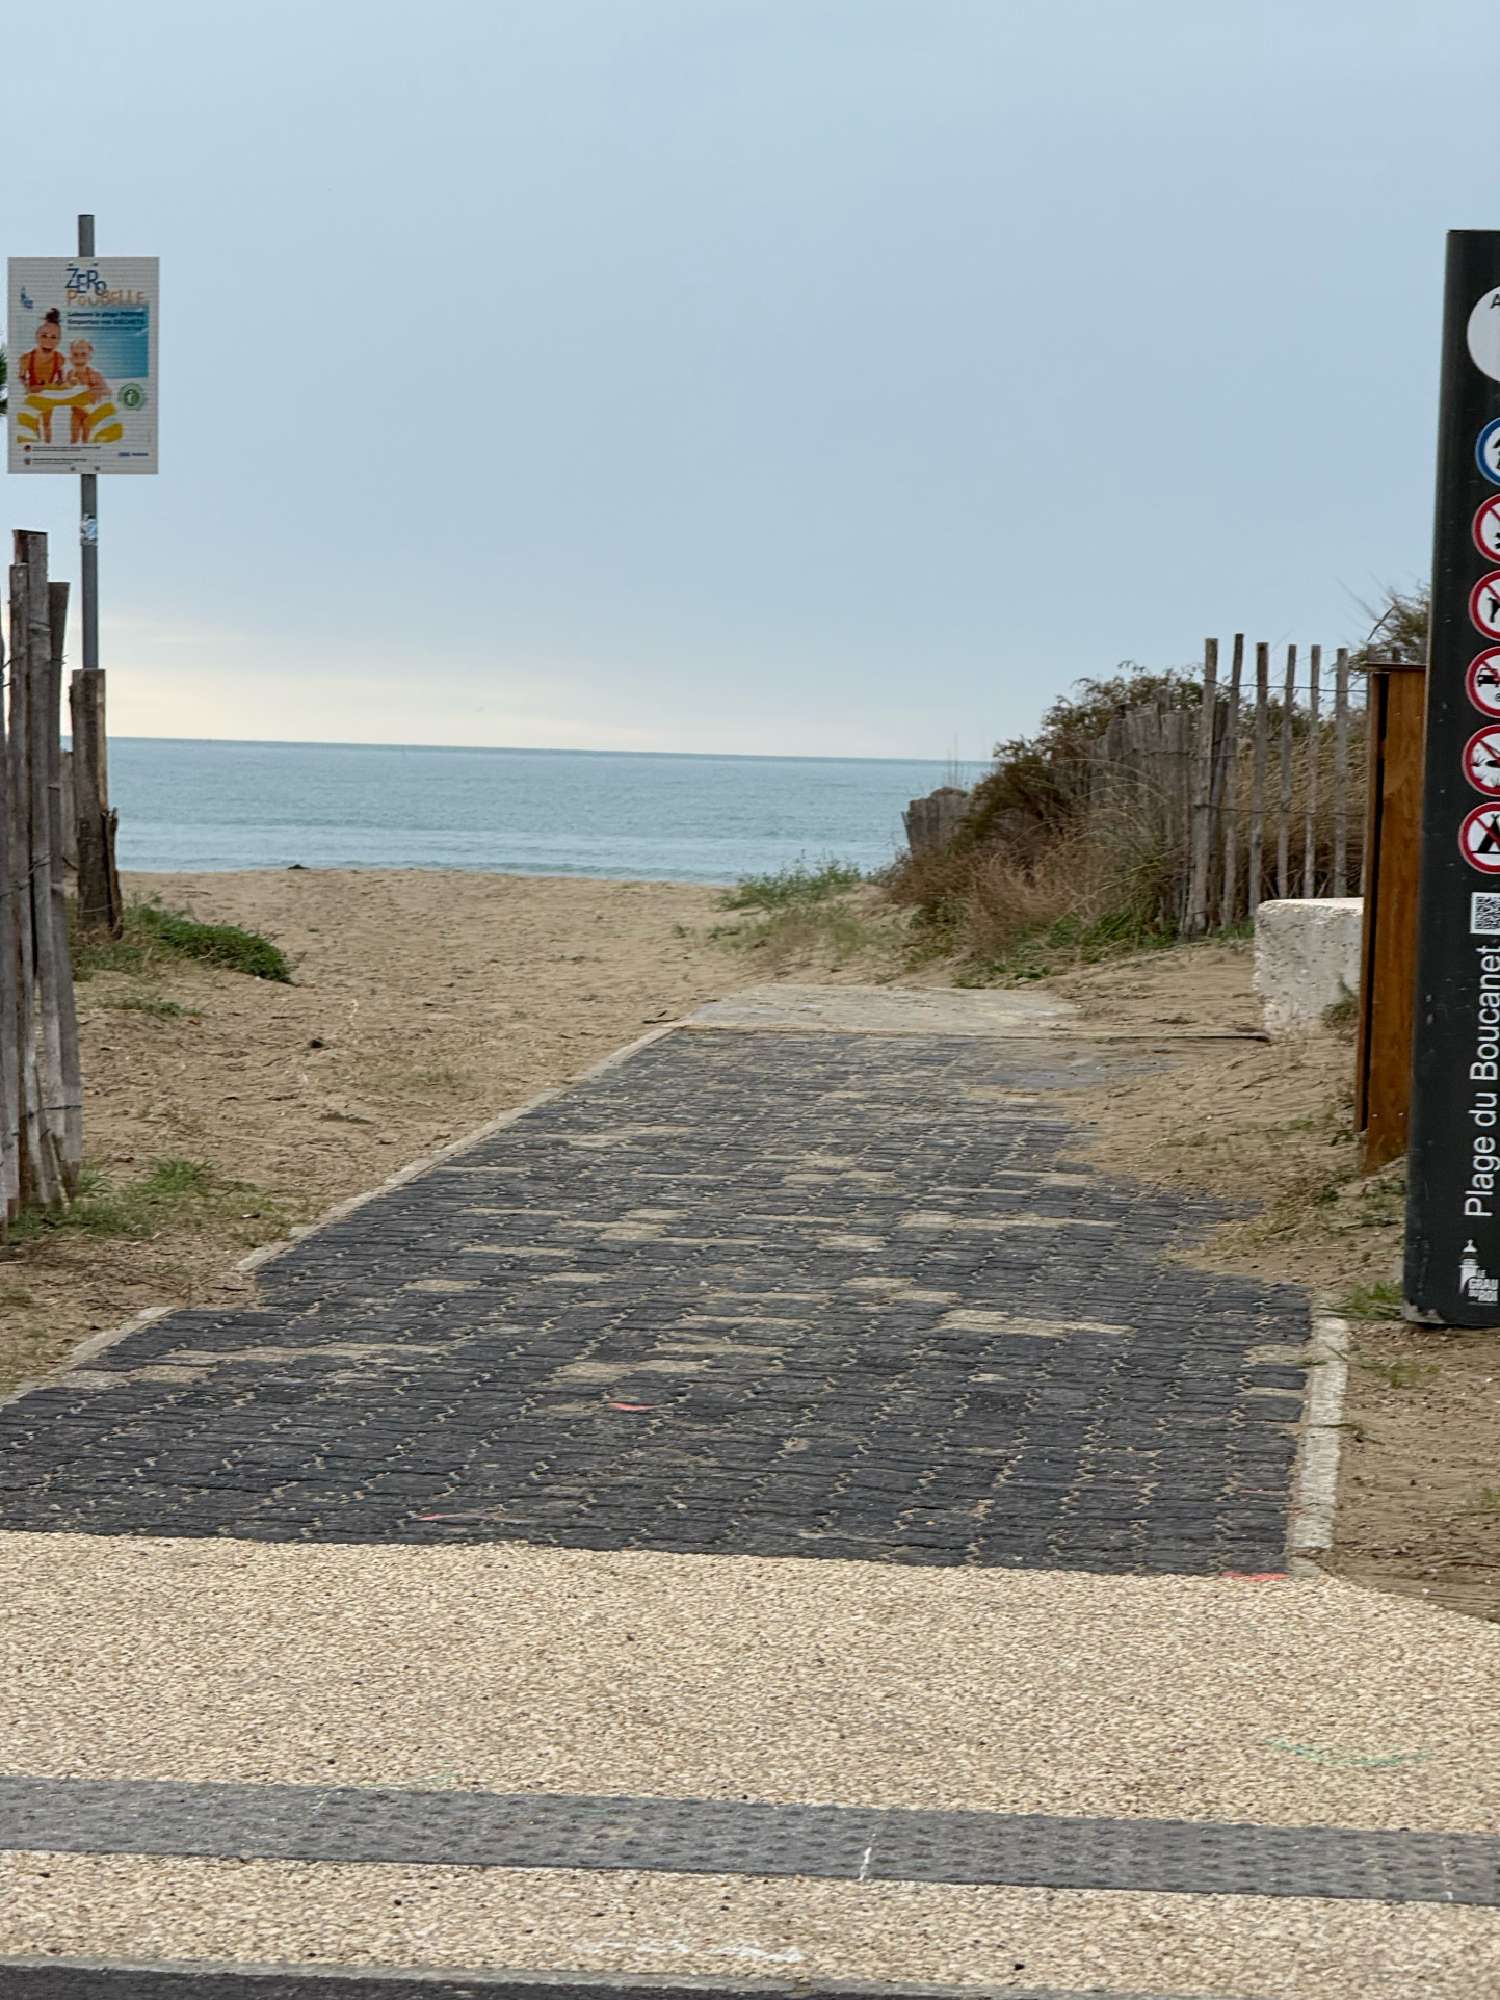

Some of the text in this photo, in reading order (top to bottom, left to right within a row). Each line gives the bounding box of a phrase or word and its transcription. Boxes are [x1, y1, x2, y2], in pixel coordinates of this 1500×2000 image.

[1464, 945, 1500, 1217] Plage du Boucanet
[1468, 1278, 1499, 1290] GRAU
